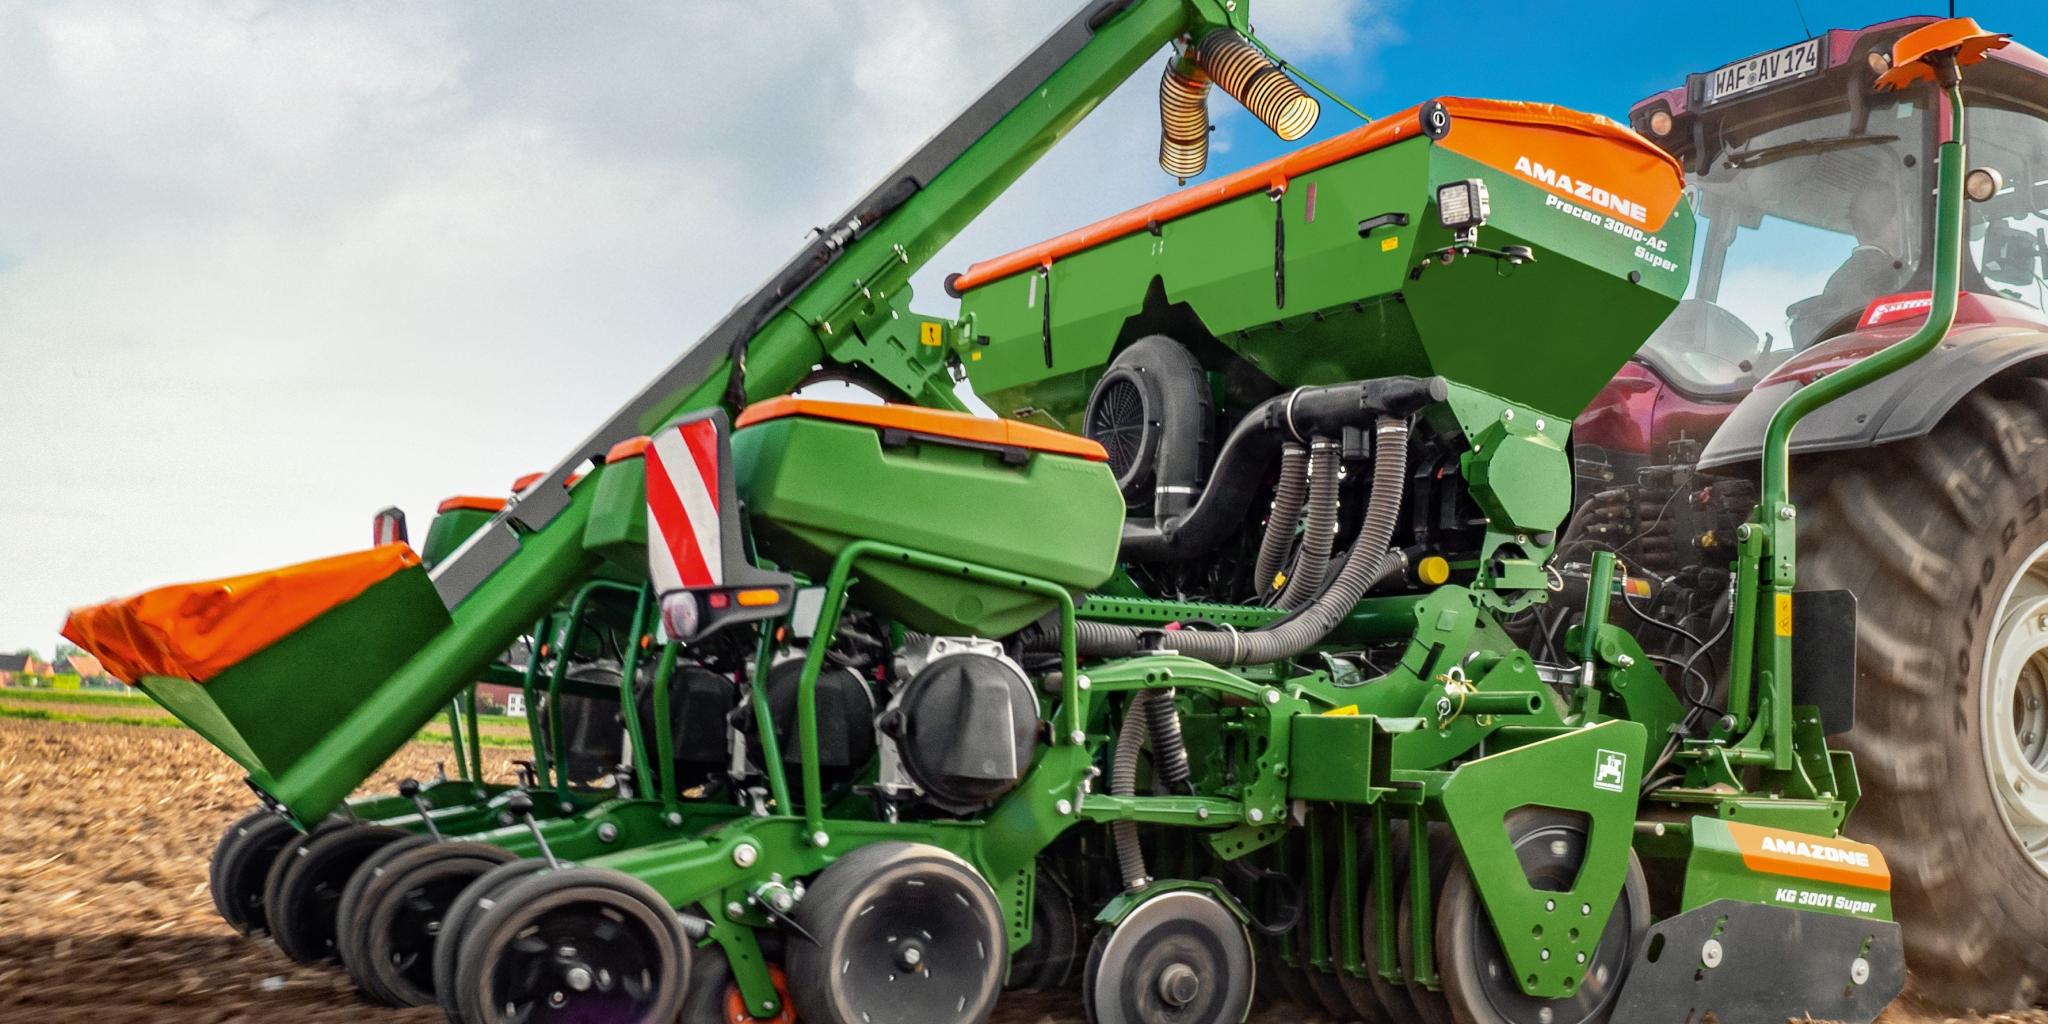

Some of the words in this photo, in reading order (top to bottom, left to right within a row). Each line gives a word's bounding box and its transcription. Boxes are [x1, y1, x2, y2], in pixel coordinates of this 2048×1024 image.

[1716, 65, 1746, 96] WAF
[1758, 58, 1781, 82] AV
[1784, 43, 1816, 74] 174
[1514, 155, 1647, 223] AMAZONE
[1545, 194, 1601, 226] Precea
[1603, 217, 1668, 253] 3000-AC
[1634, 245, 1678, 273] Super
[1761, 836, 1870, 867] AMAZONE
[1775, 888, 1797, 903] KG
[1798, 891, 1833, 908] 3001
[1834, 896, 1877, 914] Super
